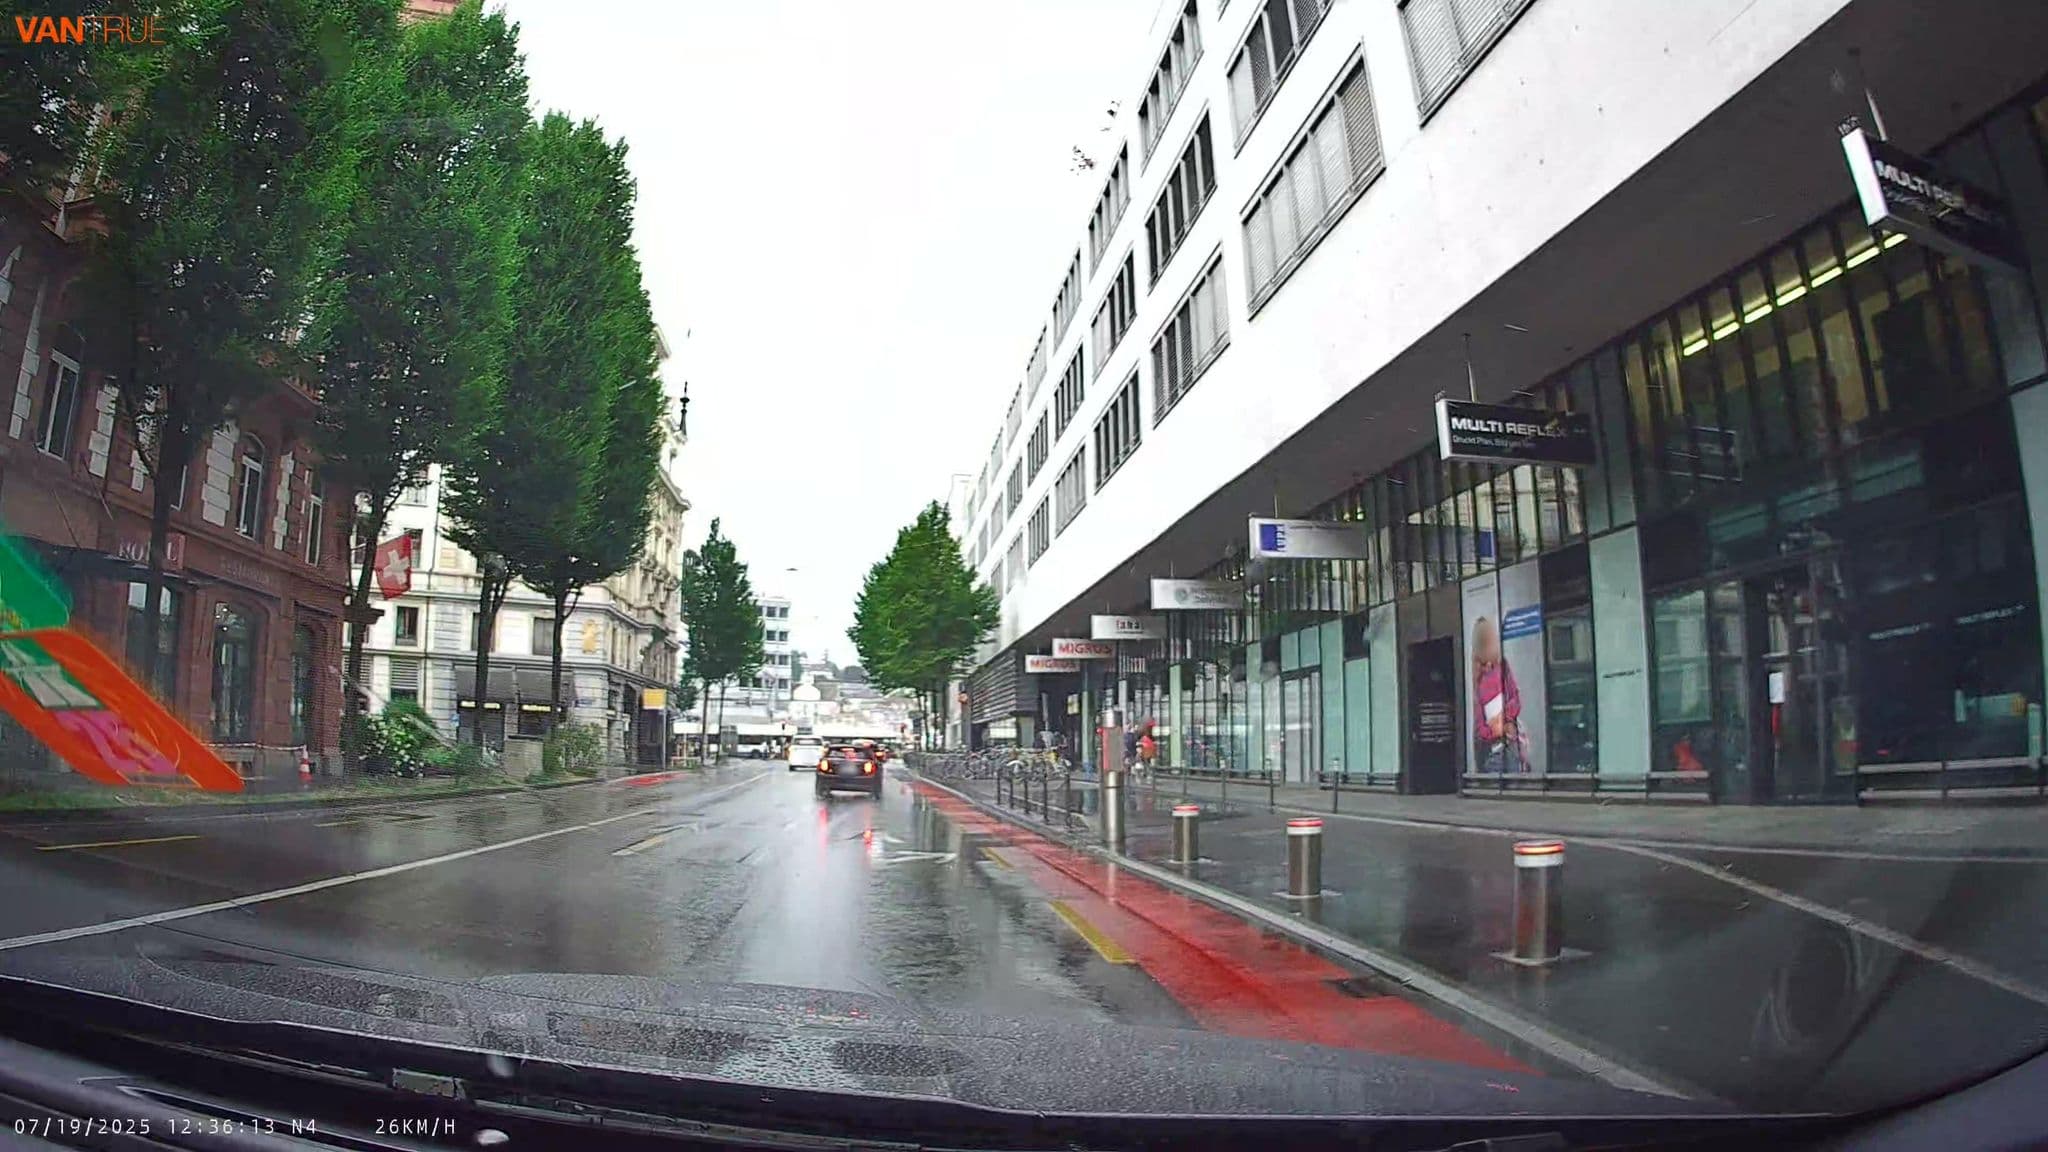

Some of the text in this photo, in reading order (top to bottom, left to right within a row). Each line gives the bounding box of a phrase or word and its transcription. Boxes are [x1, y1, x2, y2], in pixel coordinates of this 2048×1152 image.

[1875, 159, 1931, 196] MULTI
[1451, 417, 1502, 433] MULTI
[1058, 643, 1113, 654] MIGROS
[1030, 658, 1078, 669] MIGROS
